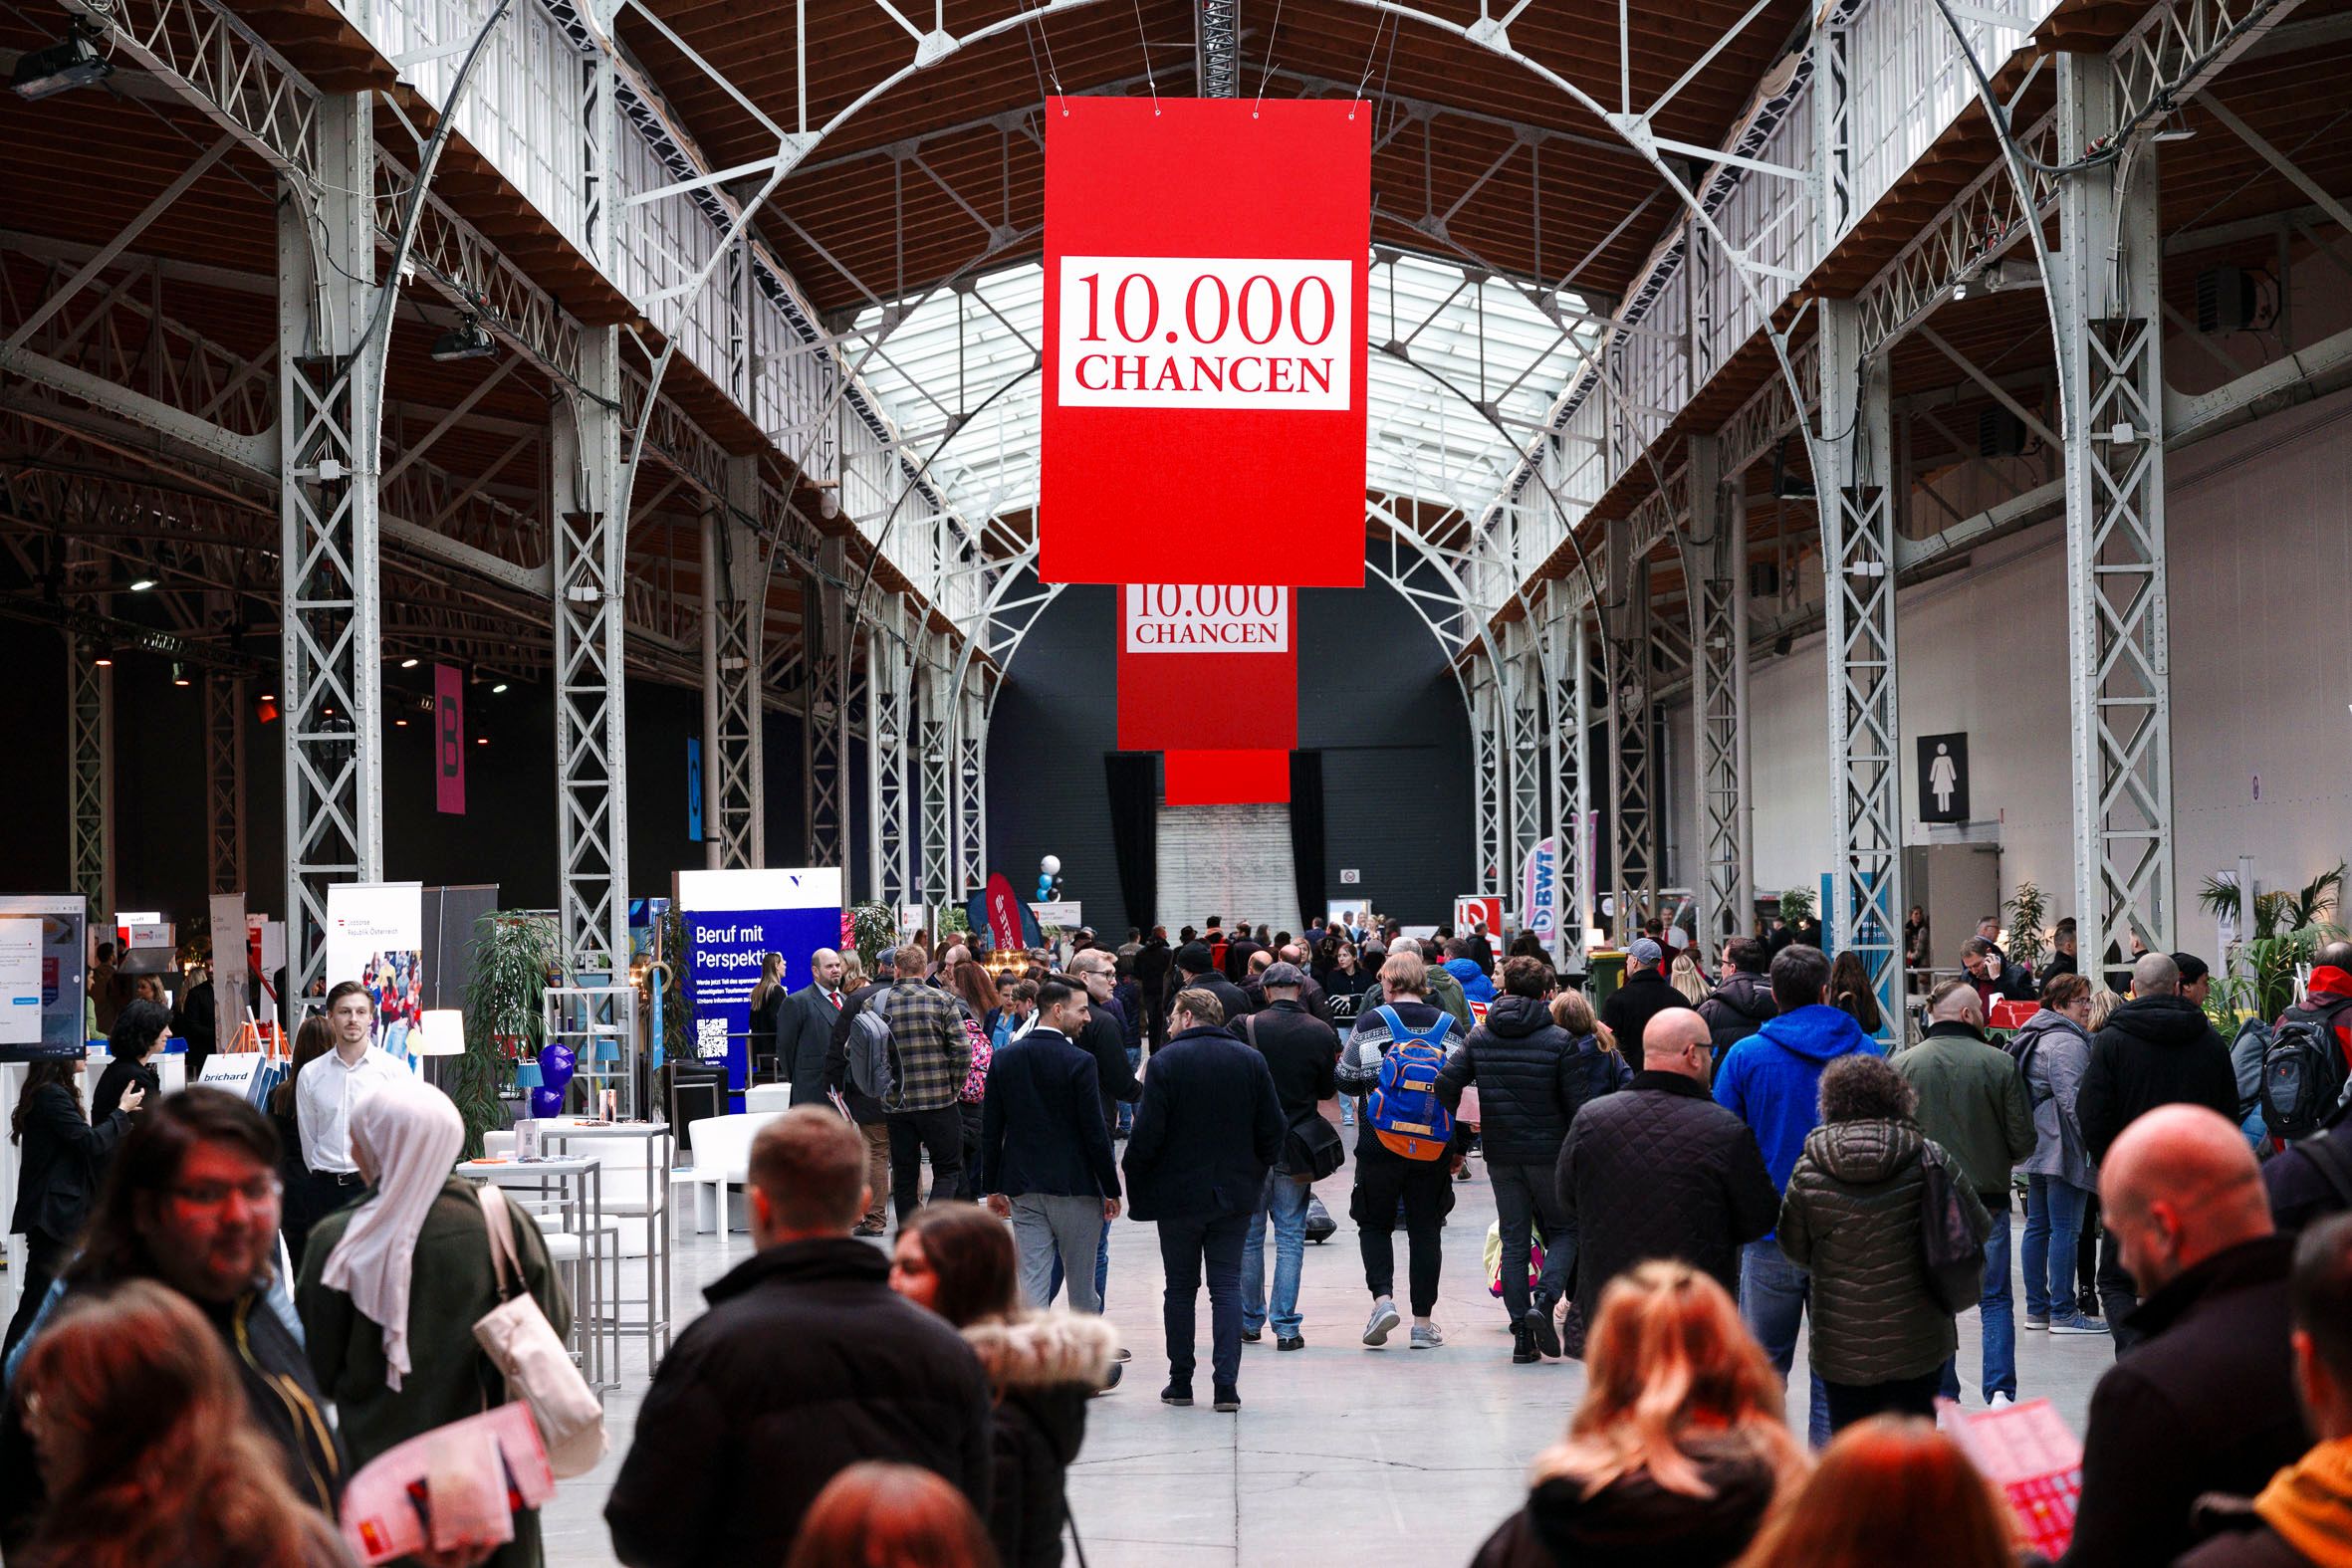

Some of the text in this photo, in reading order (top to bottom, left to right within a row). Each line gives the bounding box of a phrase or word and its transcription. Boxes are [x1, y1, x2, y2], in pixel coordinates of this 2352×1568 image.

[1078, 272, 1334, 345] 10.000
[1074, 353, 1334, 393] CHANCEN
[1136, 583, 1280, 617] 10.000
[1135, 622, 1279, 644] CHANCEN
[440, 696, 458, 778] B
[1534, 850, 1553, 906] BWT
[696, 924, 764, 944] Beruf mit
[204, 1072, 249, 1082] brichard
